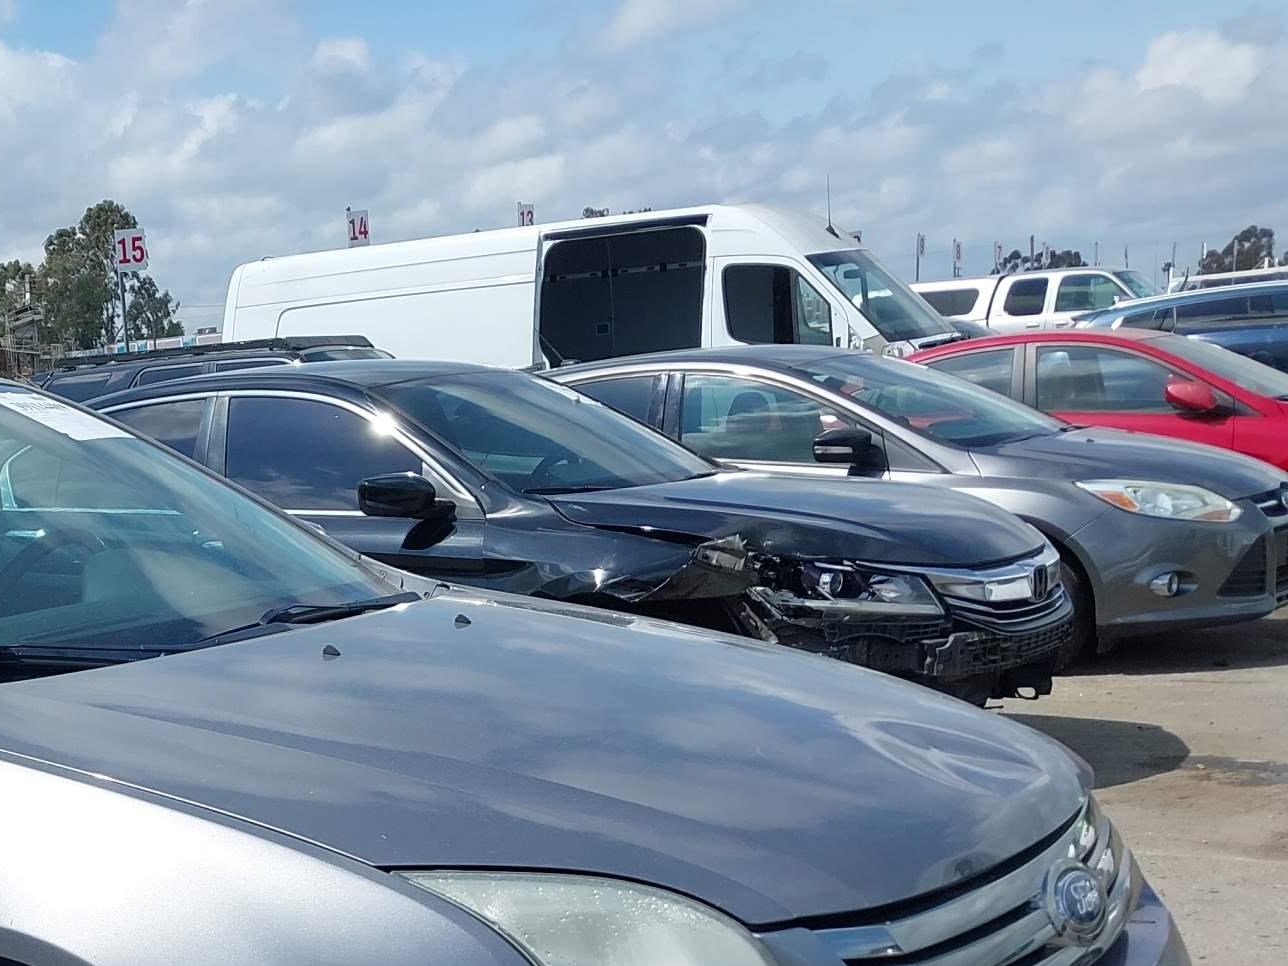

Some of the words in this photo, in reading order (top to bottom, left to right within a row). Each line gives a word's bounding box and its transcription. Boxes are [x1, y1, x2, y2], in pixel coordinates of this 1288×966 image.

[348, 216, 369, 241] 14
[519, 210, 535, 226] 13
[117, 236, 145, 264] 15
